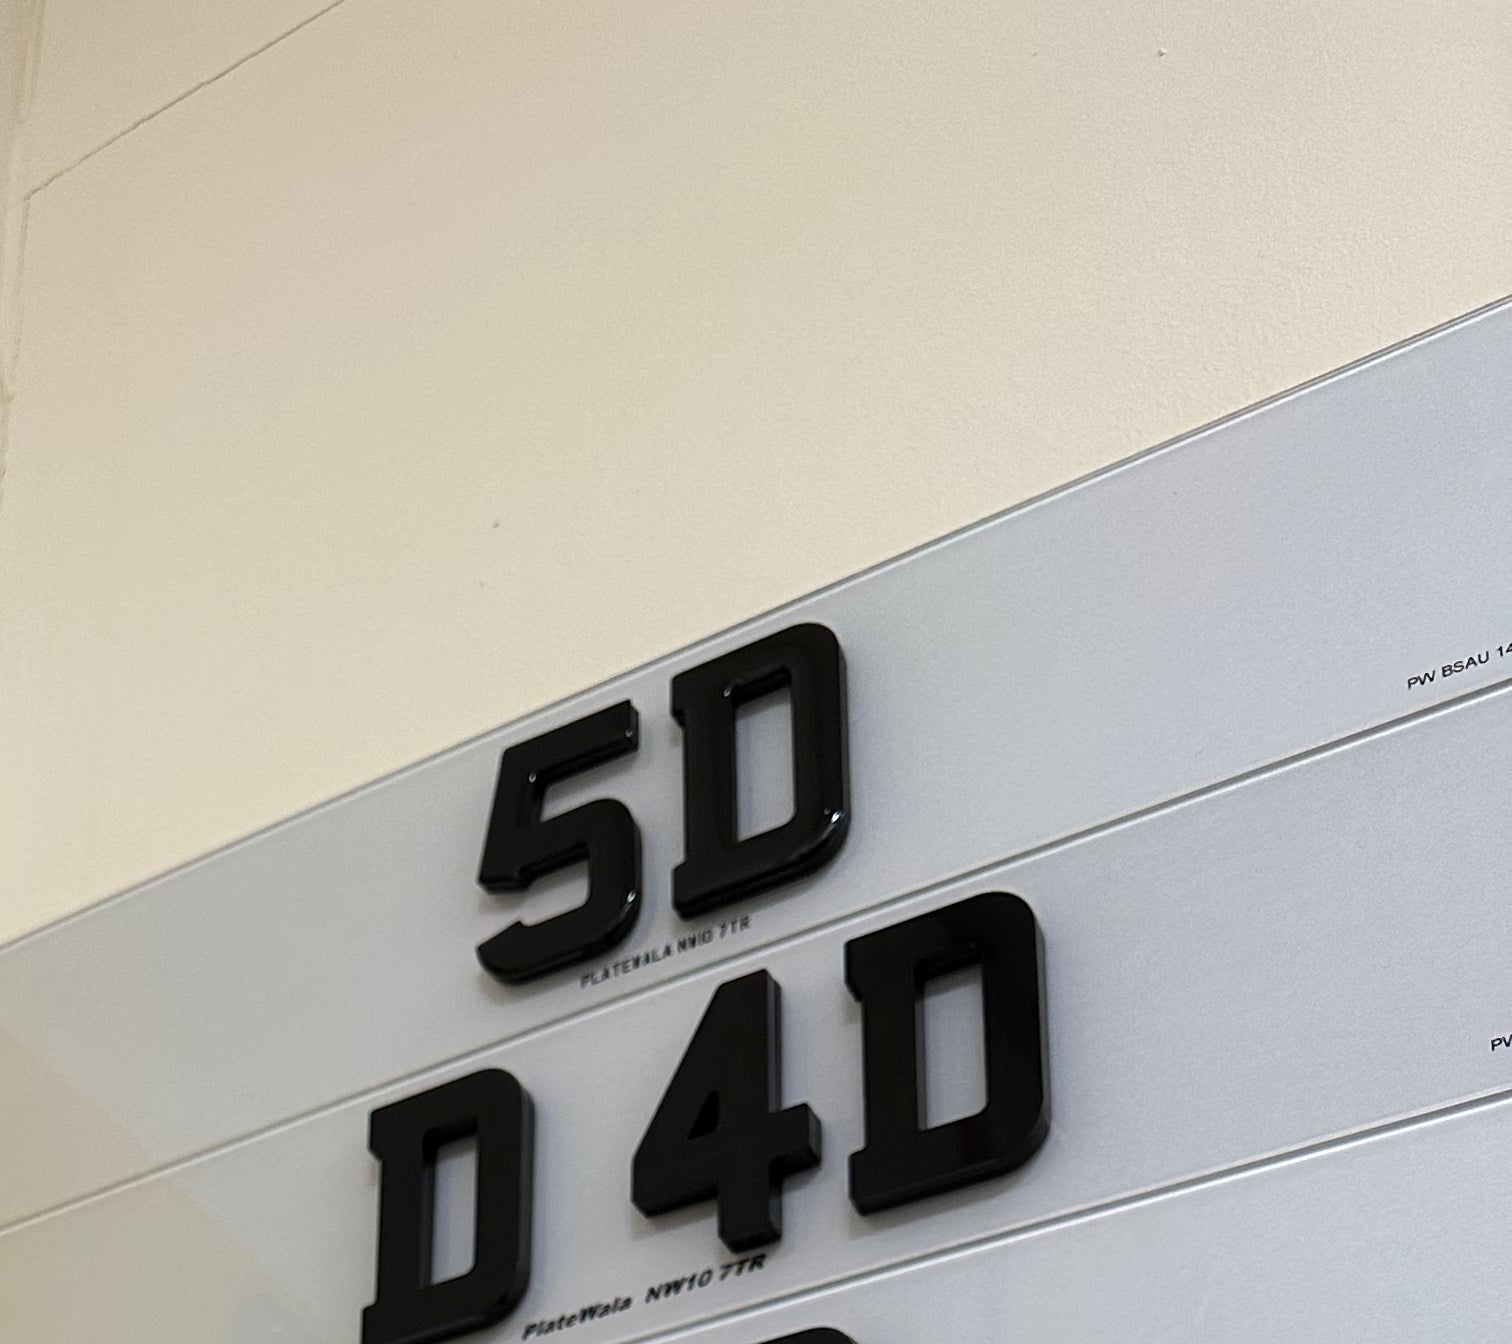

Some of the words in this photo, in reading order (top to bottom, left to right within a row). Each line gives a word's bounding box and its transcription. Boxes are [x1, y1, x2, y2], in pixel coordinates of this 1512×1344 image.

[1407, 669, 1436, 690] PW
[1441, 650, 1490, 678] BSAU
[477, 621, 851, 986] 5D
[580, 943, 672, 989] PLATEWALA
[719, 915, 751, 939] 7TR
[631, 890, 1053, 1253] 4D
[521, 1295, 632, 1341] PlateWala
[644, 1268, 714, 1304] NW10
[719, 1253, 767, 1282] 7TR
